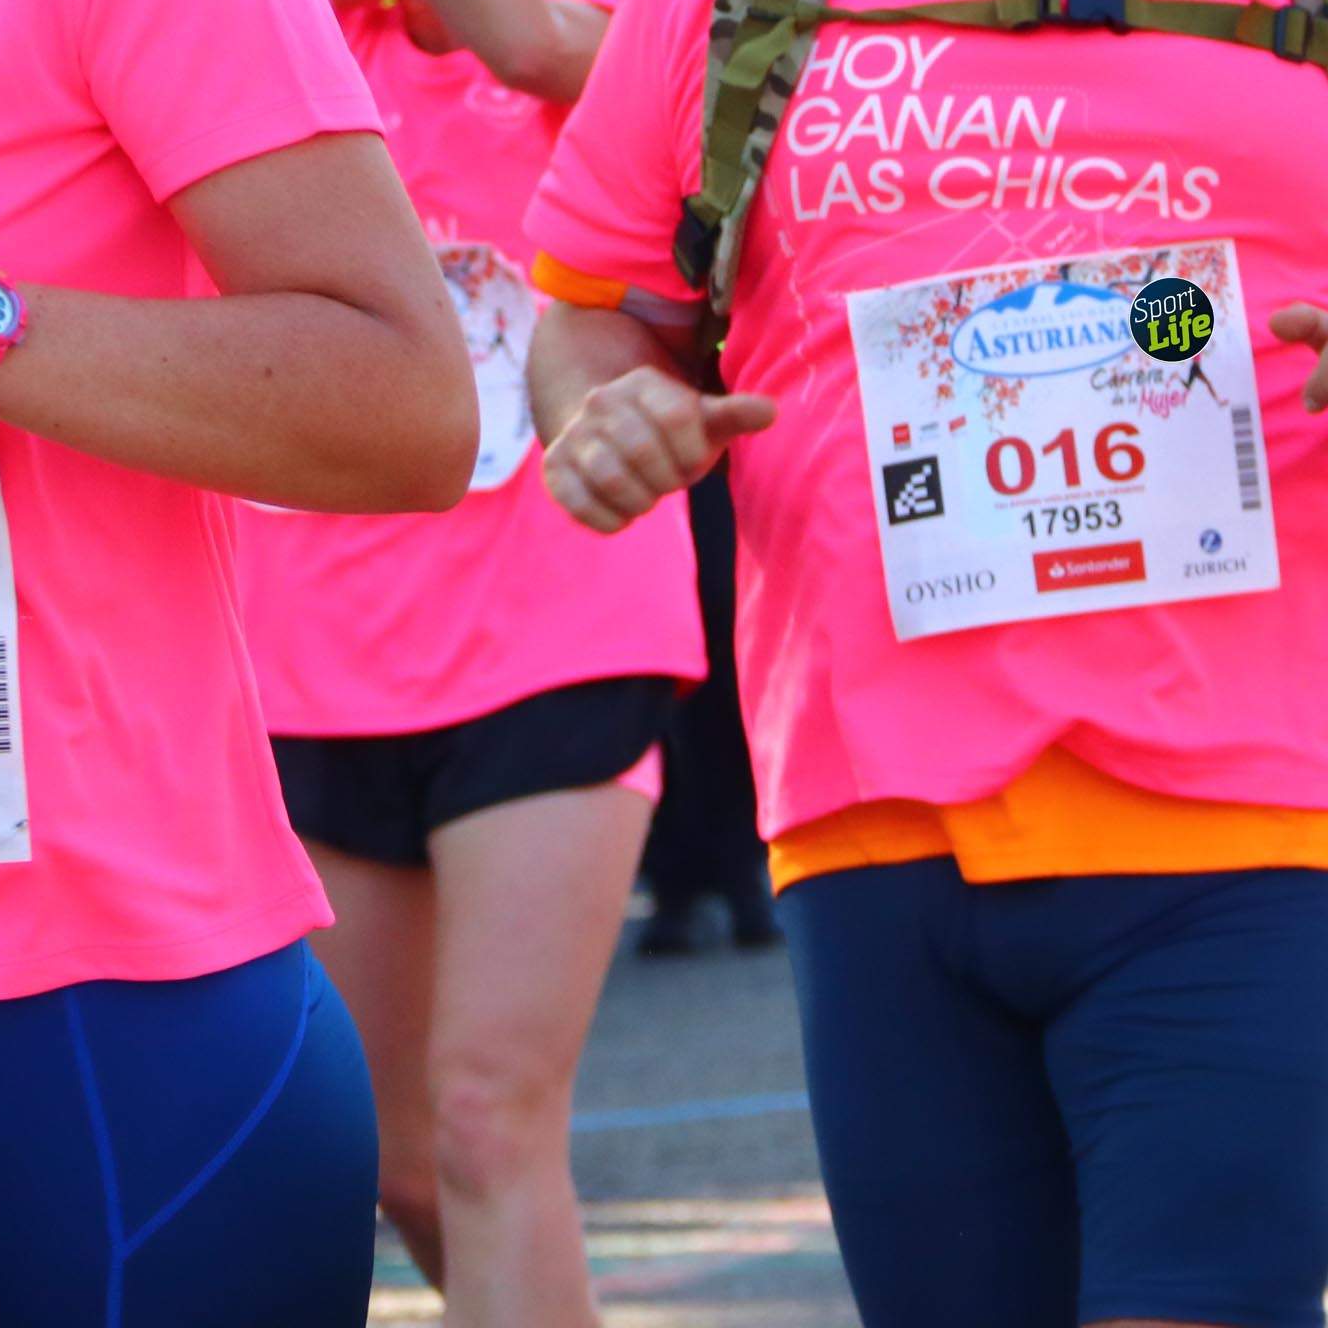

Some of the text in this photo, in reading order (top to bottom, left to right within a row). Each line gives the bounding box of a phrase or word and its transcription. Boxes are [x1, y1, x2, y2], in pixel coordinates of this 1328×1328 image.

[796, 35, 956, 95] HOY
[786, 94, 1066, 156] GANAN
[790, 156, 1221, 222] LAS CHICAS
[985, 422, 1146, 496] 016
[1022, 500, 1124, 539] 17953
[906, 569, 996, 604] OYSHO
